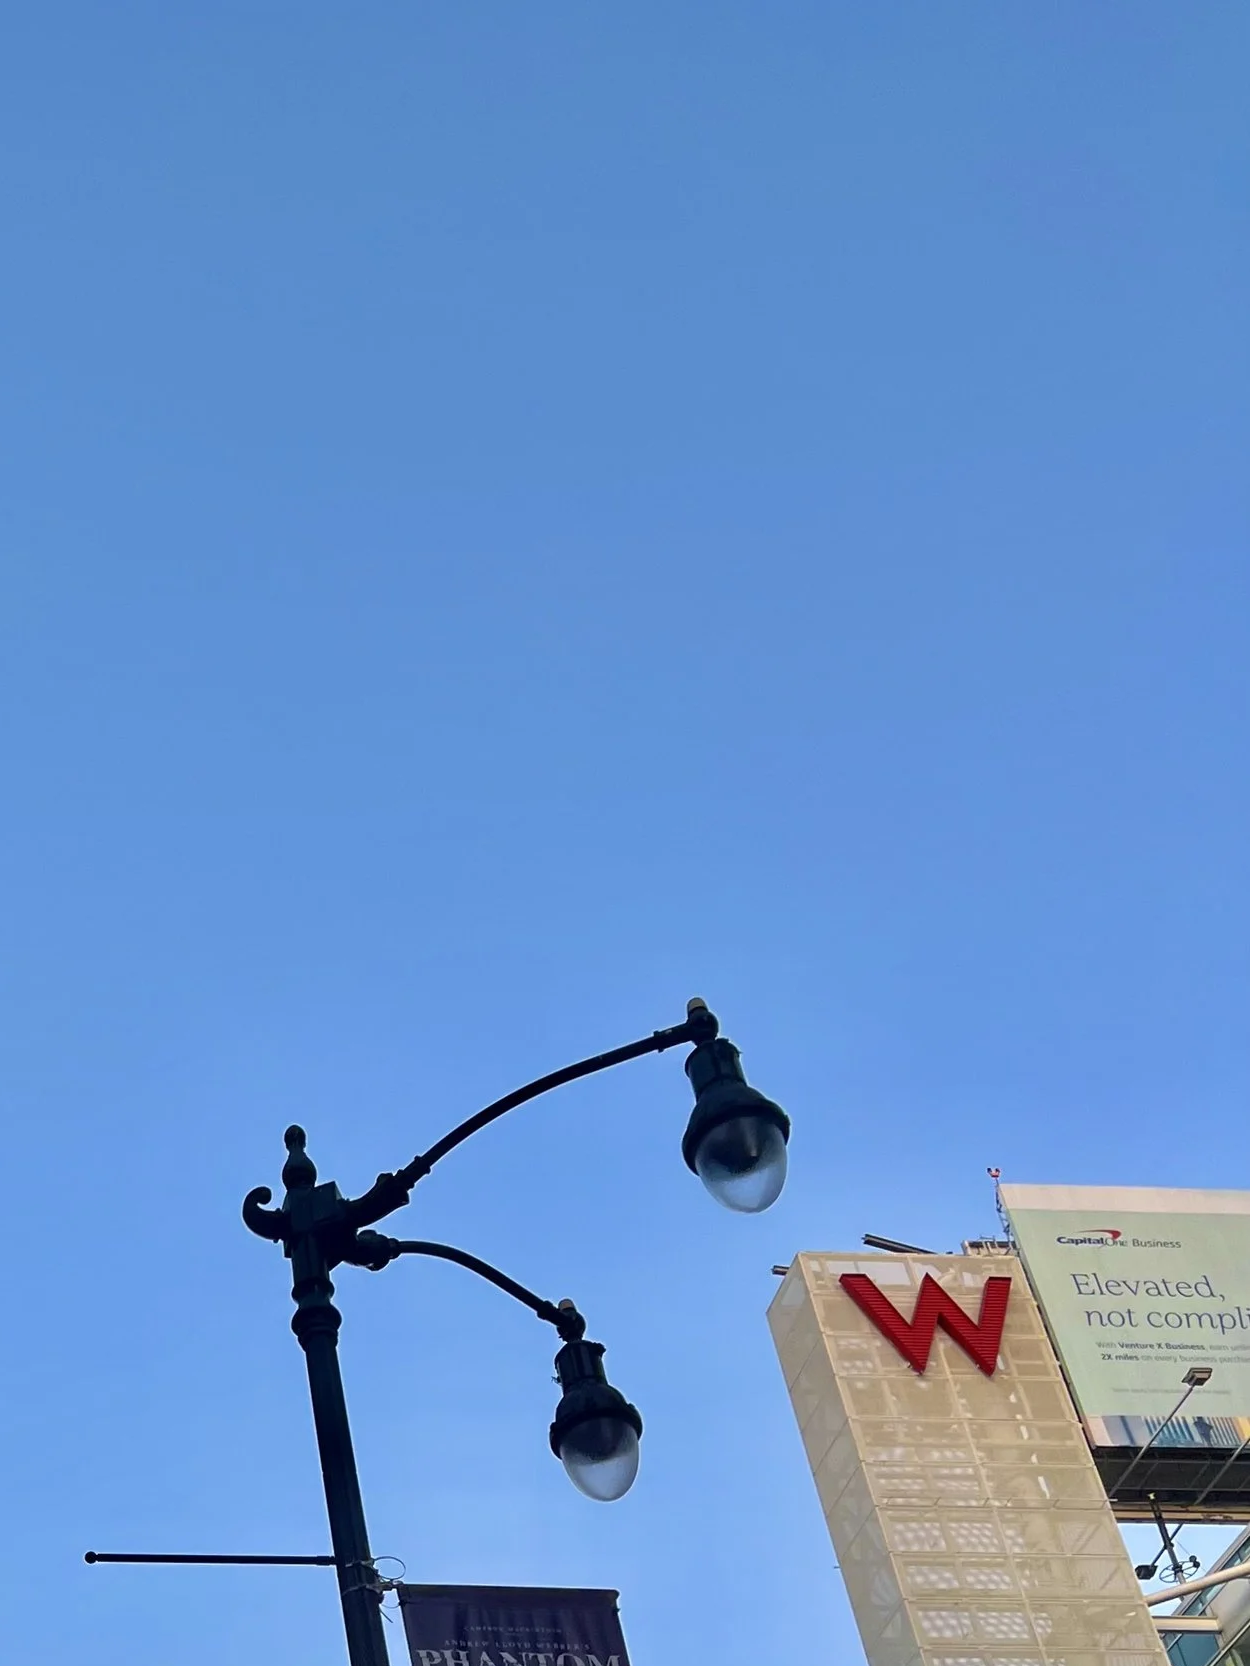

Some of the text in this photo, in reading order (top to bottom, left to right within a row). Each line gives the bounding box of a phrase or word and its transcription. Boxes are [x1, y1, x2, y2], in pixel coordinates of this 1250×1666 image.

[1132, 1238, 1182, 1249] Business
[1070, 1272, 1226, 1302] Elevated,
[839, 1272, 1012, 1377] W
[1085, 1308, 1139, 1328] not
[1118, 1341, 1155, 1350] Venture
[1115, 1353, 1140, 1361] miles
